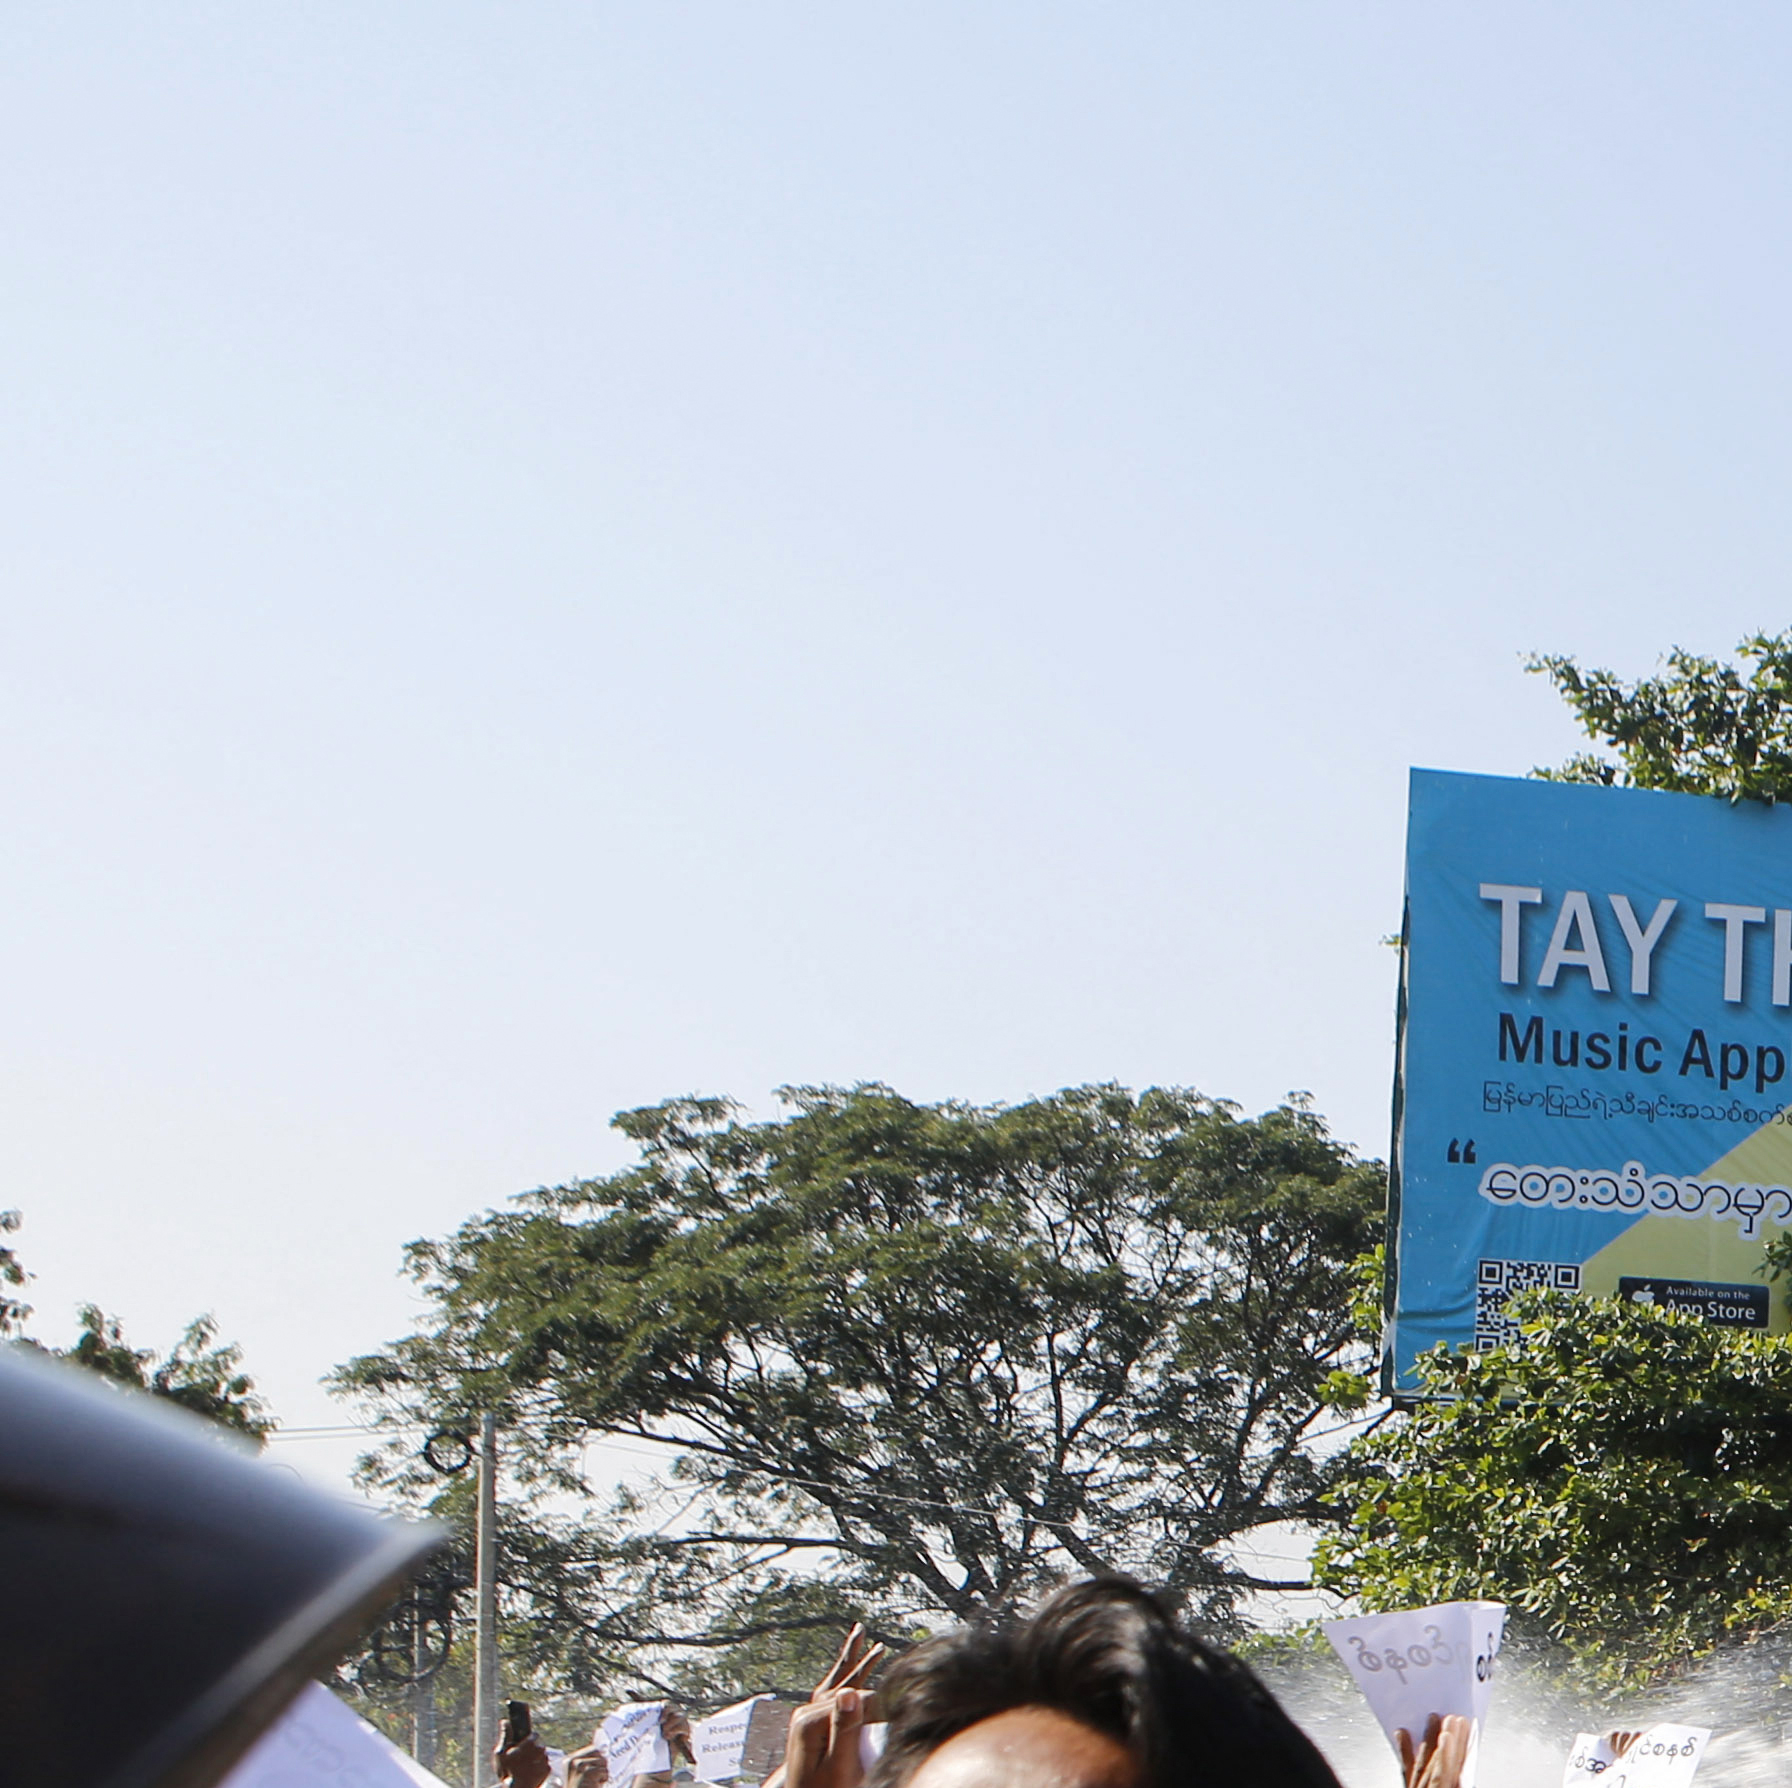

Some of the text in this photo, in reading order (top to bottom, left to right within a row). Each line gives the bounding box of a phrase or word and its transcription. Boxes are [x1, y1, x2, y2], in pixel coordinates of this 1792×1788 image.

[1478, 883, 1678, 995] TAY
[1499, 1012, 1663, 1074] Music
[1666, 1286, 1750, 1300] Available on the
[1707, 1301, 1756, 1320] Store
